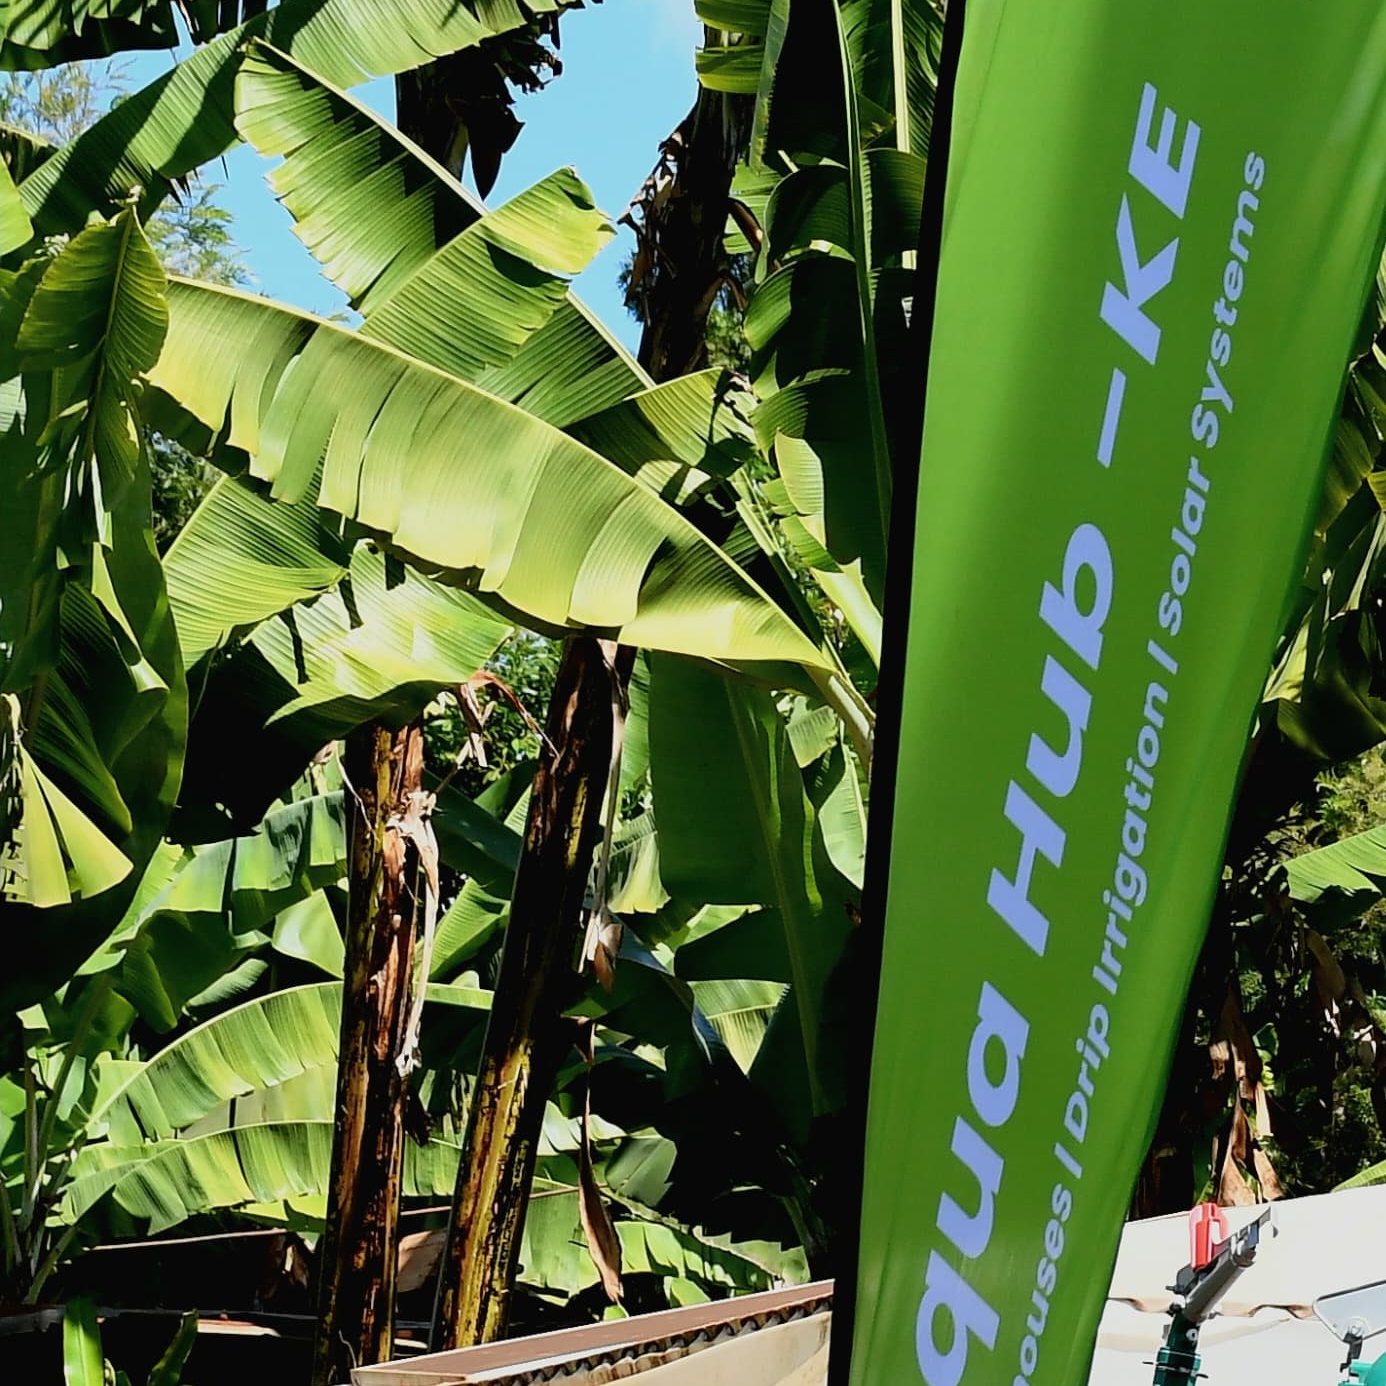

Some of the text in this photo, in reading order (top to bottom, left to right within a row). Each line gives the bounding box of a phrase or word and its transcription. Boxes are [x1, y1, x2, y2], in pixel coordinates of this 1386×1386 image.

[987, 522, 1114, 957] Hub
[1064, 1004, 1111, 1143] Drip
[1092, 682, 1168, 994] Irrigation
[1158, 457, 1210, 636] Solar
[1191, 151, 1266, 448] Systems
